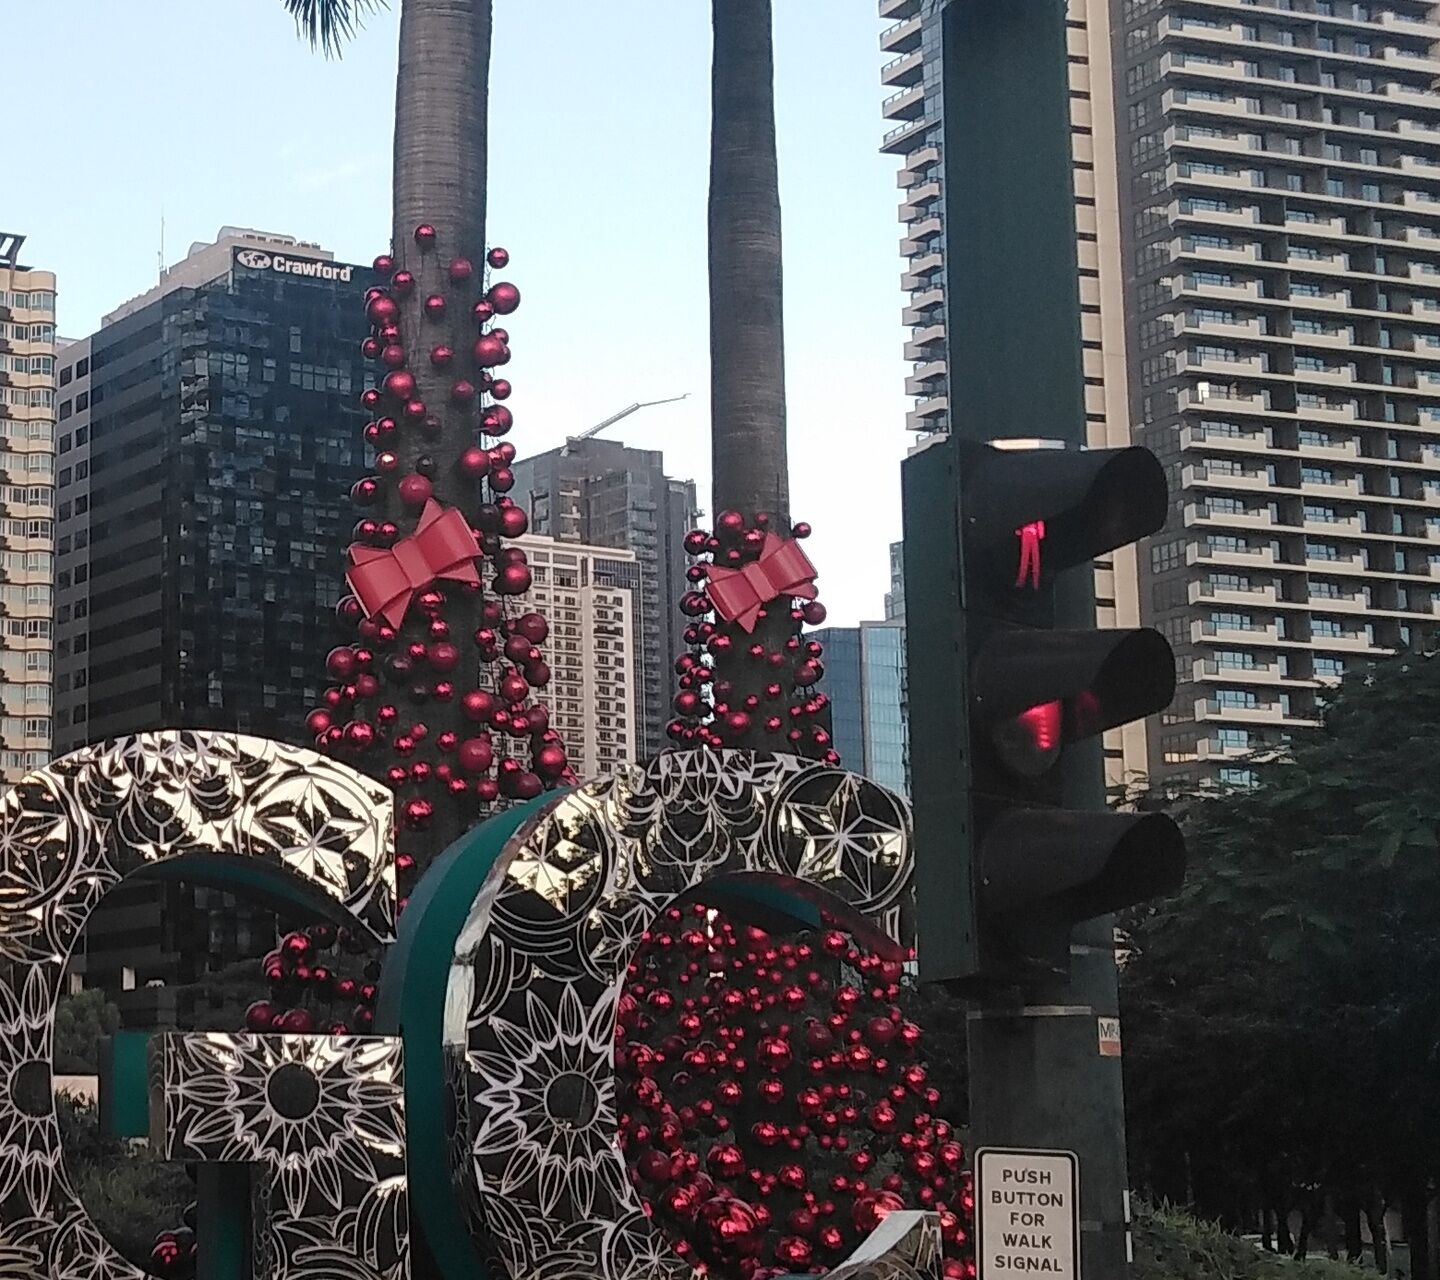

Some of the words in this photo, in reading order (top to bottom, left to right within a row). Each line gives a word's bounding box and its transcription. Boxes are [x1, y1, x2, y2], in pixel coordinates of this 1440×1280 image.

[273, 255, 352, 282] Crawford
[1002, 1168, 1052, 1184] PUSH
[991, 1190, 1064, 1207] BUTTON
[1009, 1212, 1045, 1227] FOR
[1002, 1232, 1053, 1250] WALK
[994, 1255, 1063, 1273] SIGNAL
